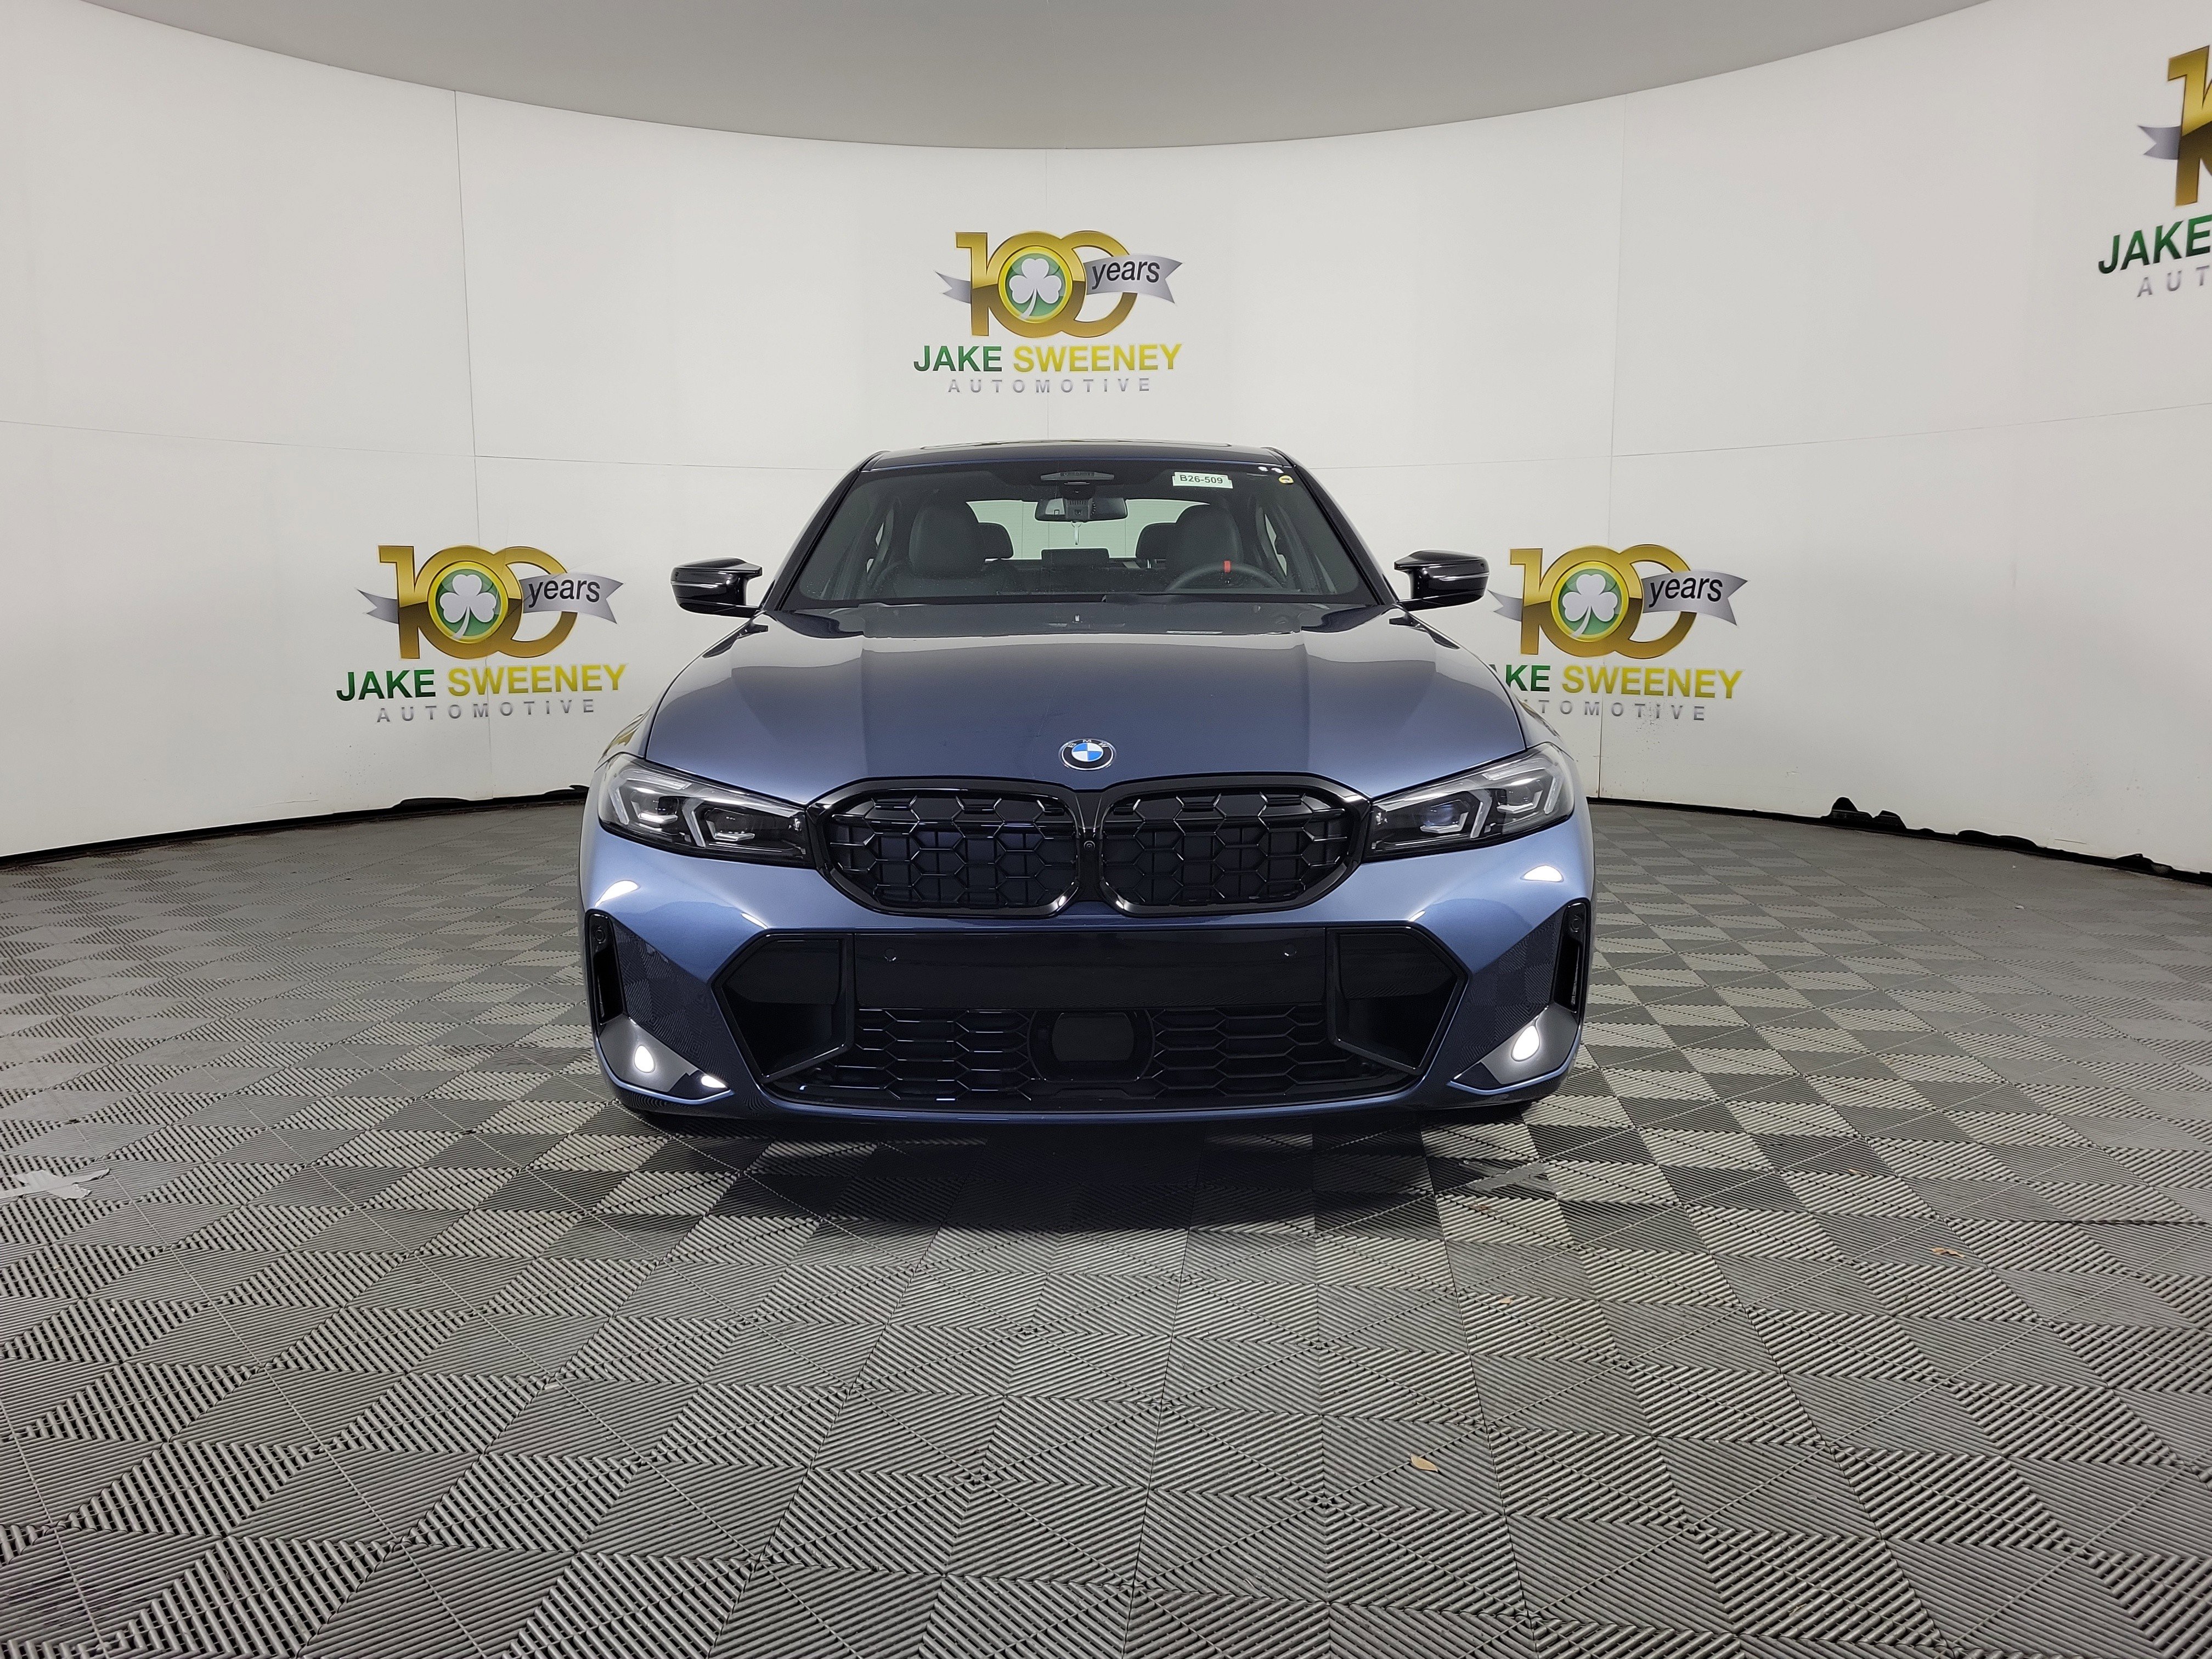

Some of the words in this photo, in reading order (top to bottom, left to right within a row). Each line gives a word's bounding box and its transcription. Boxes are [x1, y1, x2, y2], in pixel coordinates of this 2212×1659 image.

[2098, 213, 2212, 274] JAKE
[955, 230, 1138, 338] 100
[1091, 261, 1160, 290] years
[913, 345, 1003, 372] JAKE
[1013, 343, 1183, 373] SWEENEY
[947, 378, 1150, 393] AUTOMOTIVE
[1180, 475, 1223, 484] B26-509
[378, 545, 578, 660] 100
[528, 579, 601, 607] years
[1509, 544, 1697, 659] 100
[1649, 577, 1723, 608] years
[336, 669, 436, 702] JAKE
[447, 664, 627, 697] SWEENEY
[1488, 664, 1551, 692] KE
[1561, 665, 1744, 699] SWEENEY
[376, 699, 595, 723] AUTOMOTIVE
[1523, 699, 1705, 721] TOMOTIVE
